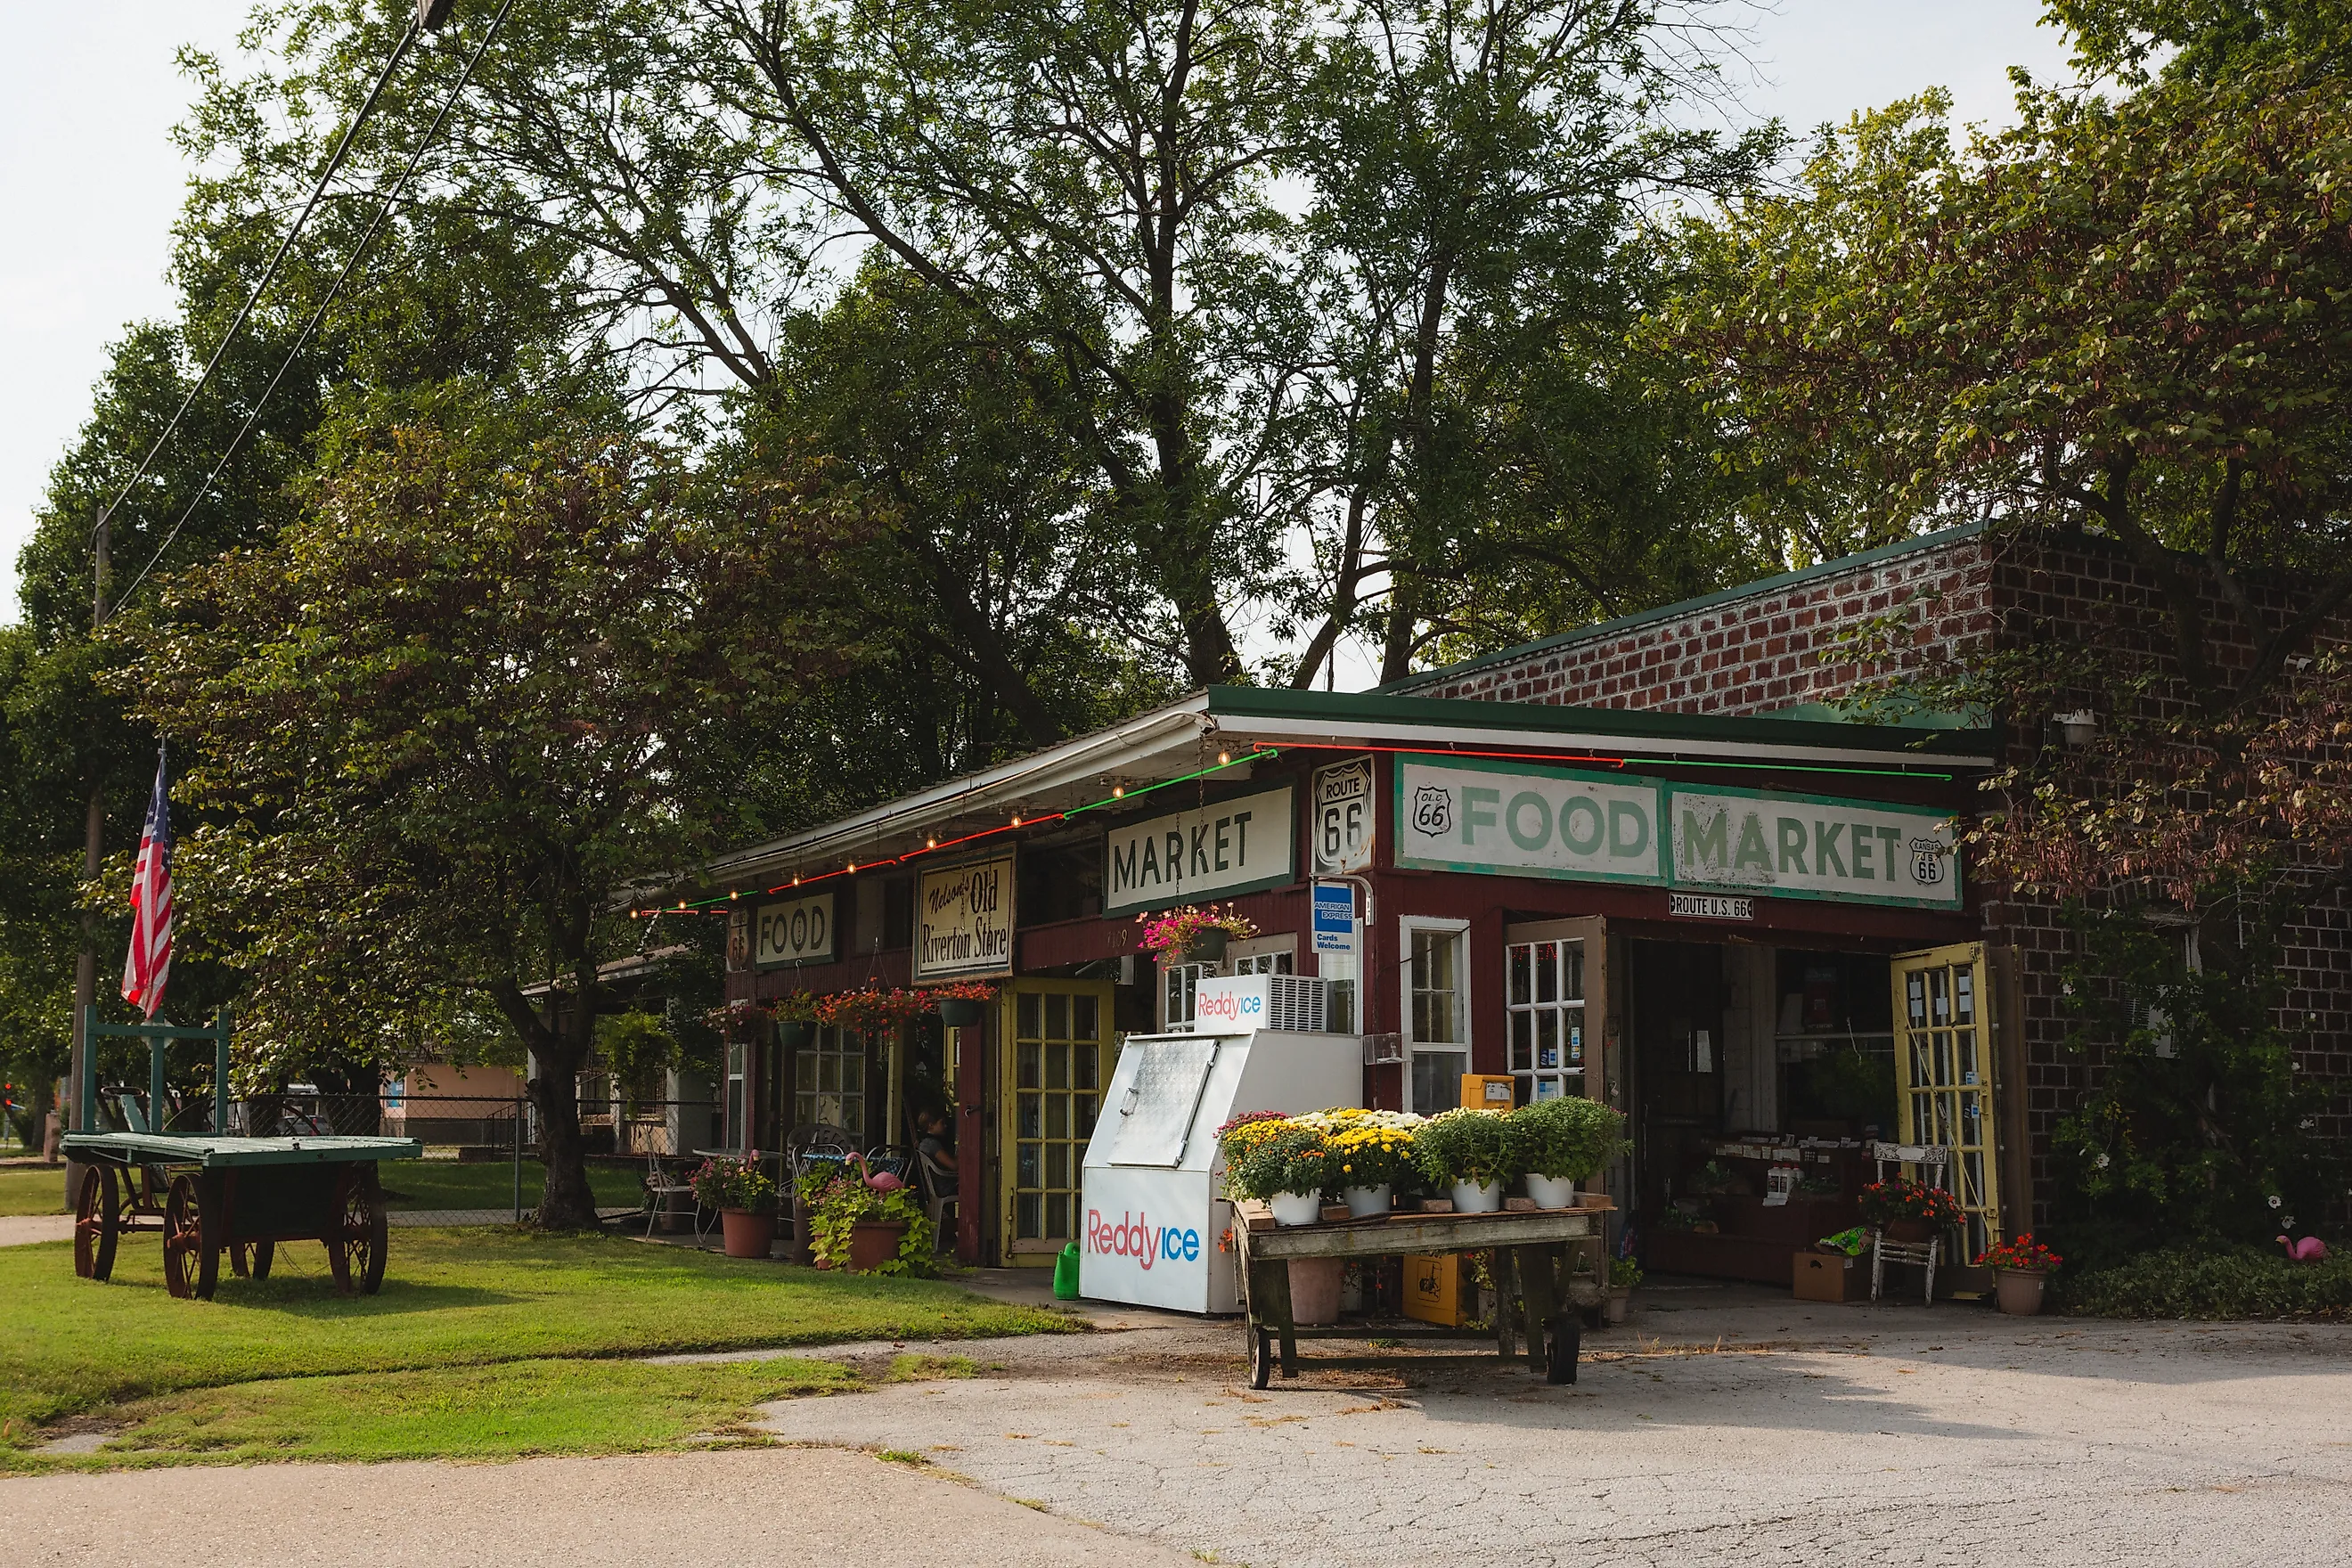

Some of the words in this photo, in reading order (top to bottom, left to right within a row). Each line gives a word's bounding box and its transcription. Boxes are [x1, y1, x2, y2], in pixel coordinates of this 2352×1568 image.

[1326, 777, 1360, 800] ROUTE
[1418, 804, 1446, 827] 66
[1461, 786, 1649, 858] FOOD
[1324, 802, 1362, 857] 66
[1114, 811, 1252, 894] MARKET
[1682, 810, 1901, 882] MARKET
[1918, 862, 1936, 879] 66
[970, 869, 999, 914] Old
[1314, 901, 1350, 911] AMERICAN
[1322, 911, 1353, 920] EXPRESS
[1676, 896, 1708, 914] ROUTE
[1711, 898, 1731, 916] U.S.
[1734, 900, 1747, 917] 66
[760, 905, 826, 957] FOOD
[922, 923, 971, 965] Riverton
[974, 916, 1007, 959] Store
[1316, 933, 1338, 942] Cards
[1316, 941, 1351, 951] Welcome
